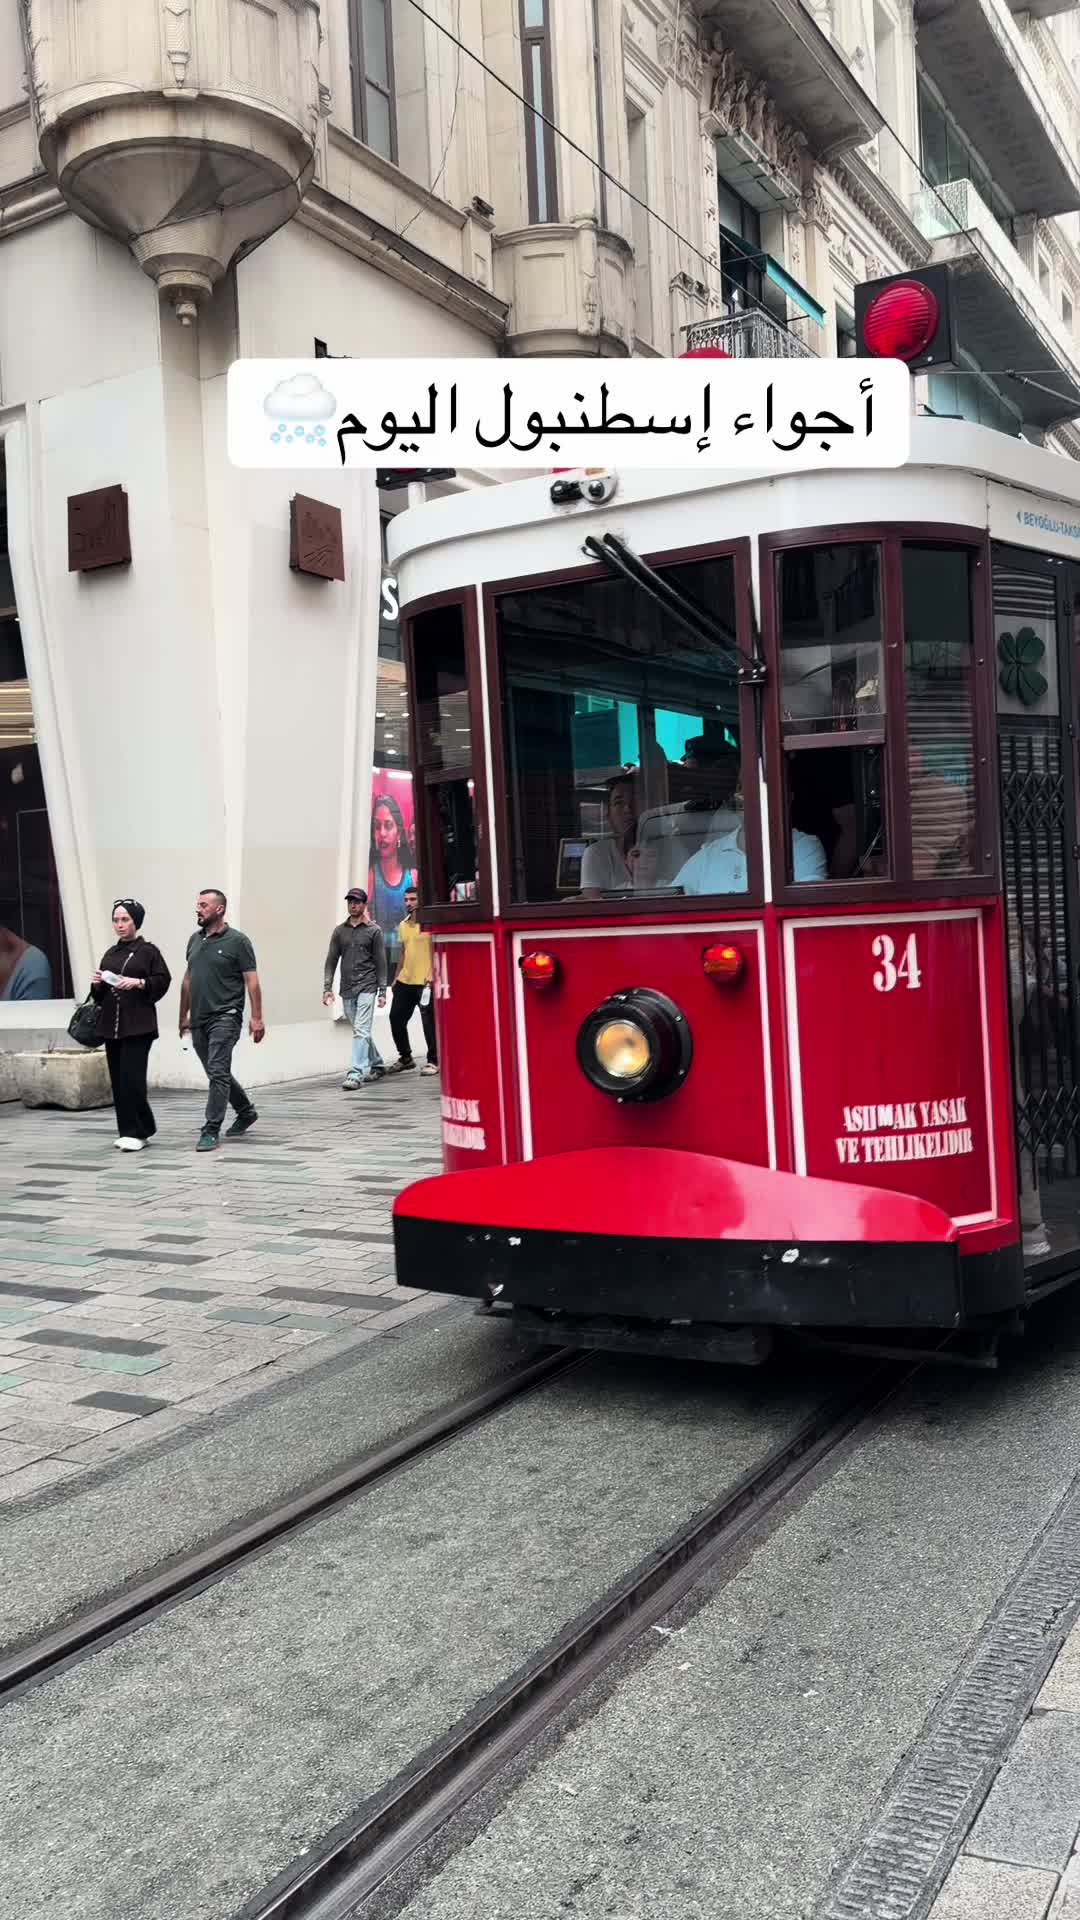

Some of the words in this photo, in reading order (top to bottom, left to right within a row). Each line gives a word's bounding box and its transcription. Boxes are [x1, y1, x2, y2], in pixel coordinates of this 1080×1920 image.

[871, 932, 922, 992] 34
[919, 1096, 968, 1128] YASAK
[835, 1137, 860, 1164] VE
